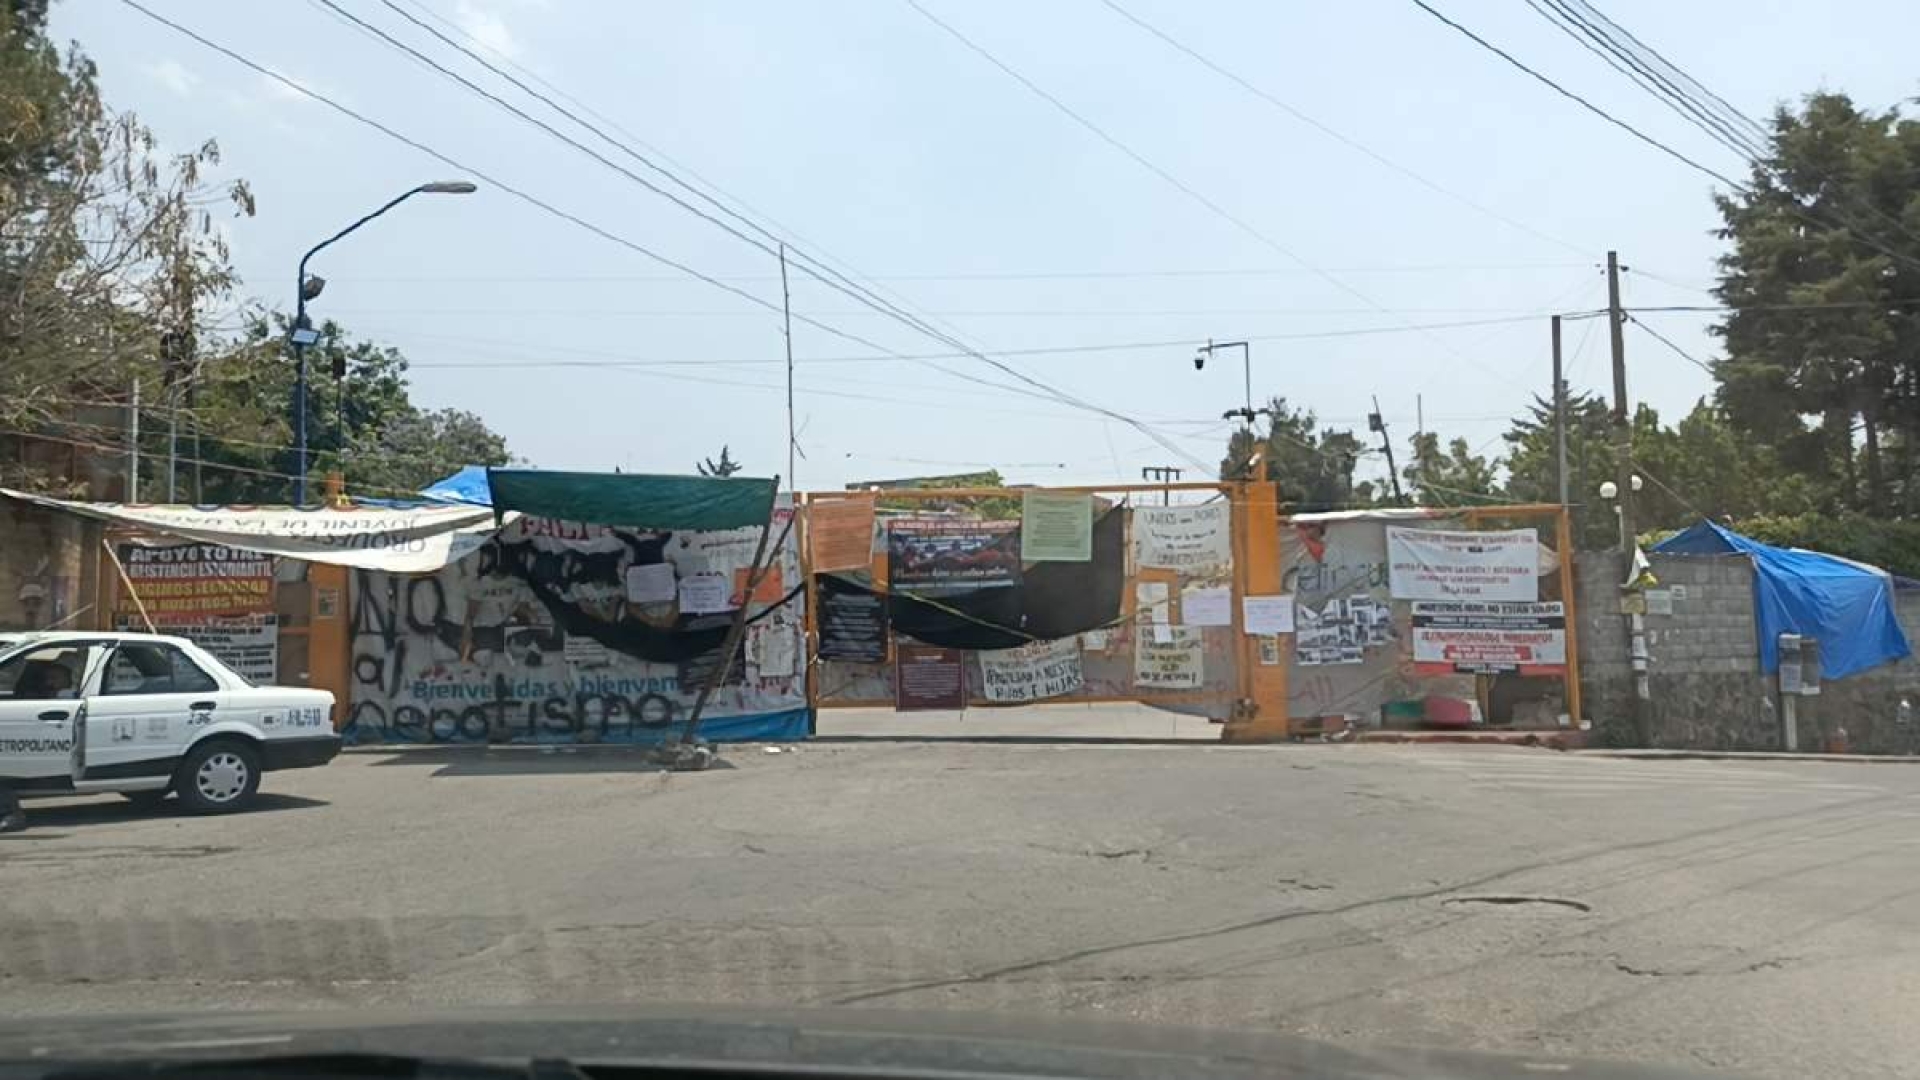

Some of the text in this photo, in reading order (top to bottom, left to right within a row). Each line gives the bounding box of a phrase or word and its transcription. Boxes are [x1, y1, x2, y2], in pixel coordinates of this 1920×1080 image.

[413, 678, 560, 703] Bienveidas
[580, 674, 679, 694] bienven
[0, 738, 71, 753] ETROPOLITANO
